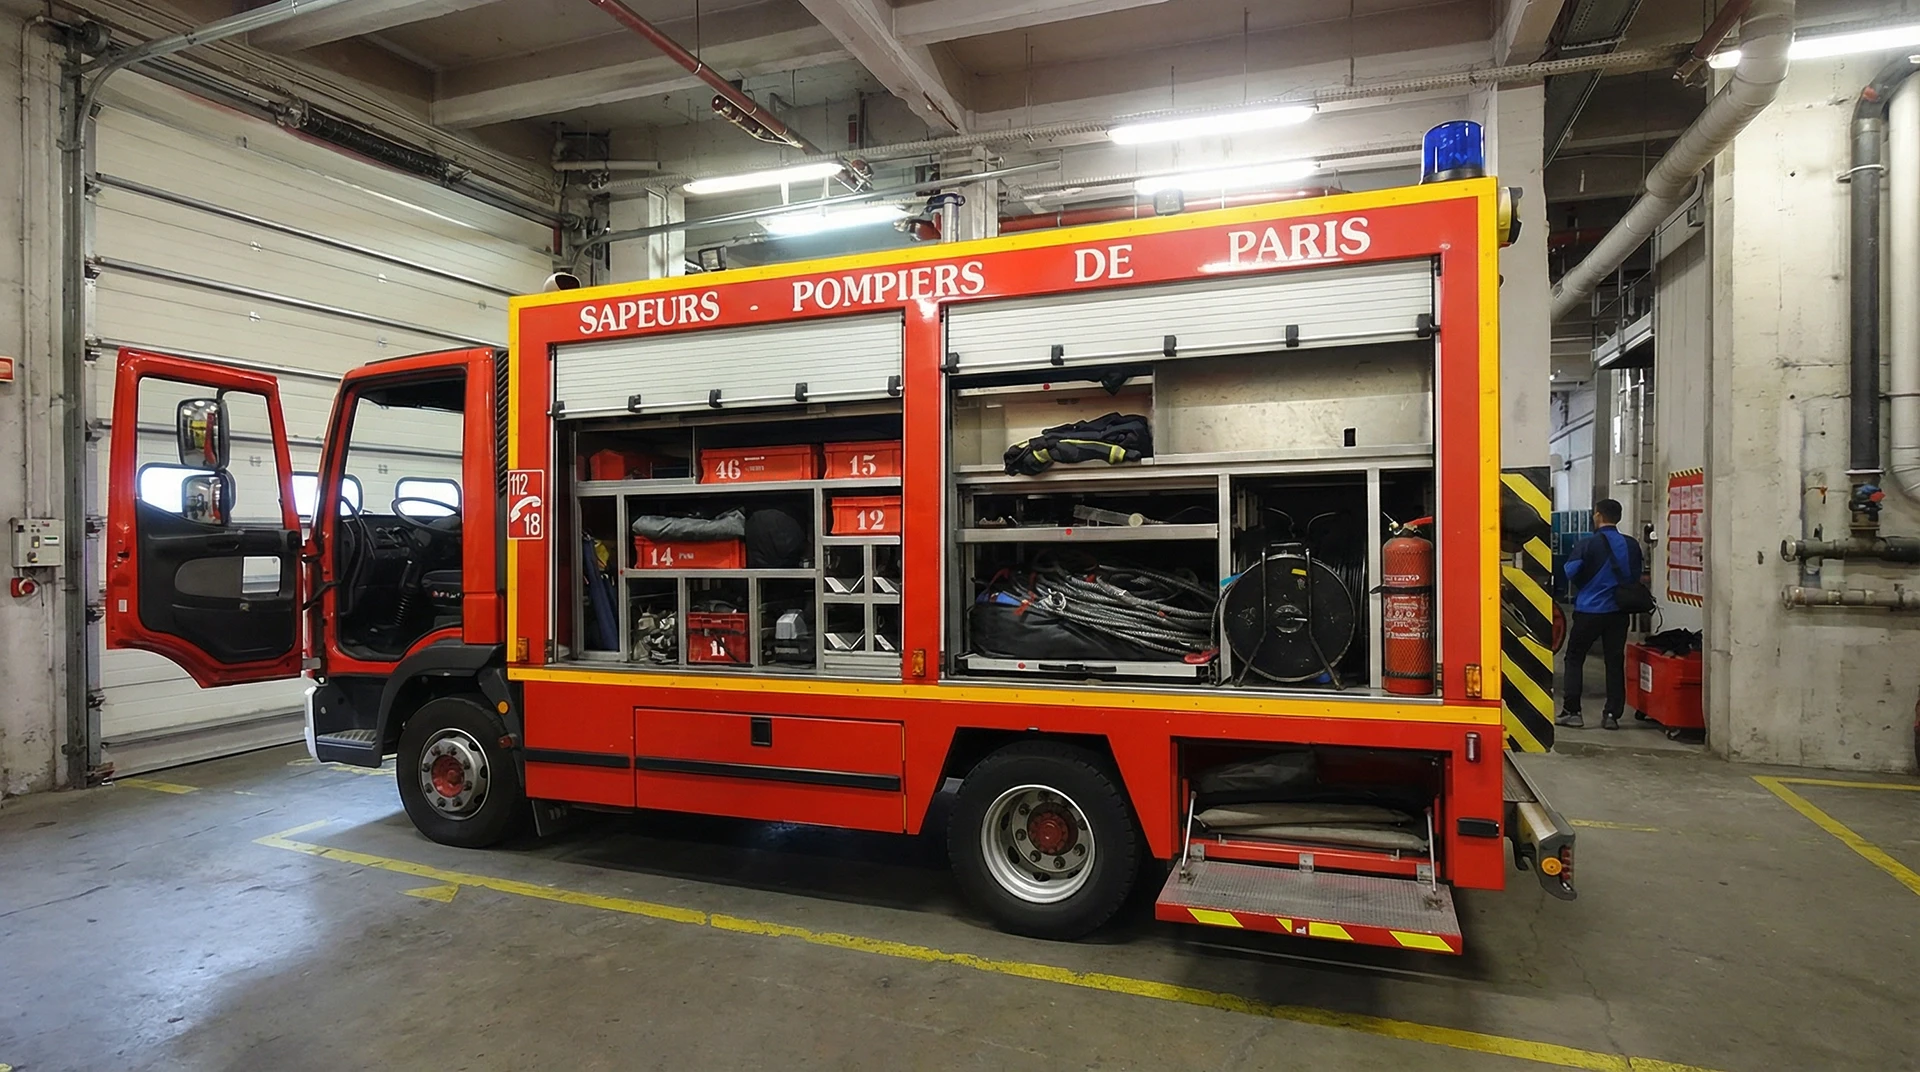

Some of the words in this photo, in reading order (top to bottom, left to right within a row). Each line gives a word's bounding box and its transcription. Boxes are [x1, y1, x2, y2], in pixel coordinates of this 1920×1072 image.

[579, 291, 720, 335] SAPEURS
[792, 261, 986, 312] POMPIERS
[1074, 244, 1135, 283] DE
[1227, 217, 1371, 267] PARIS
[715, 459, 741, 479] 46
[850, 455, 876, 475] 15
[510, 473, 529, 496] 112
[523, 513, 541, 536] 18
[856, 509, 885, 531] 12
[651, 547, 673, 566] 14
